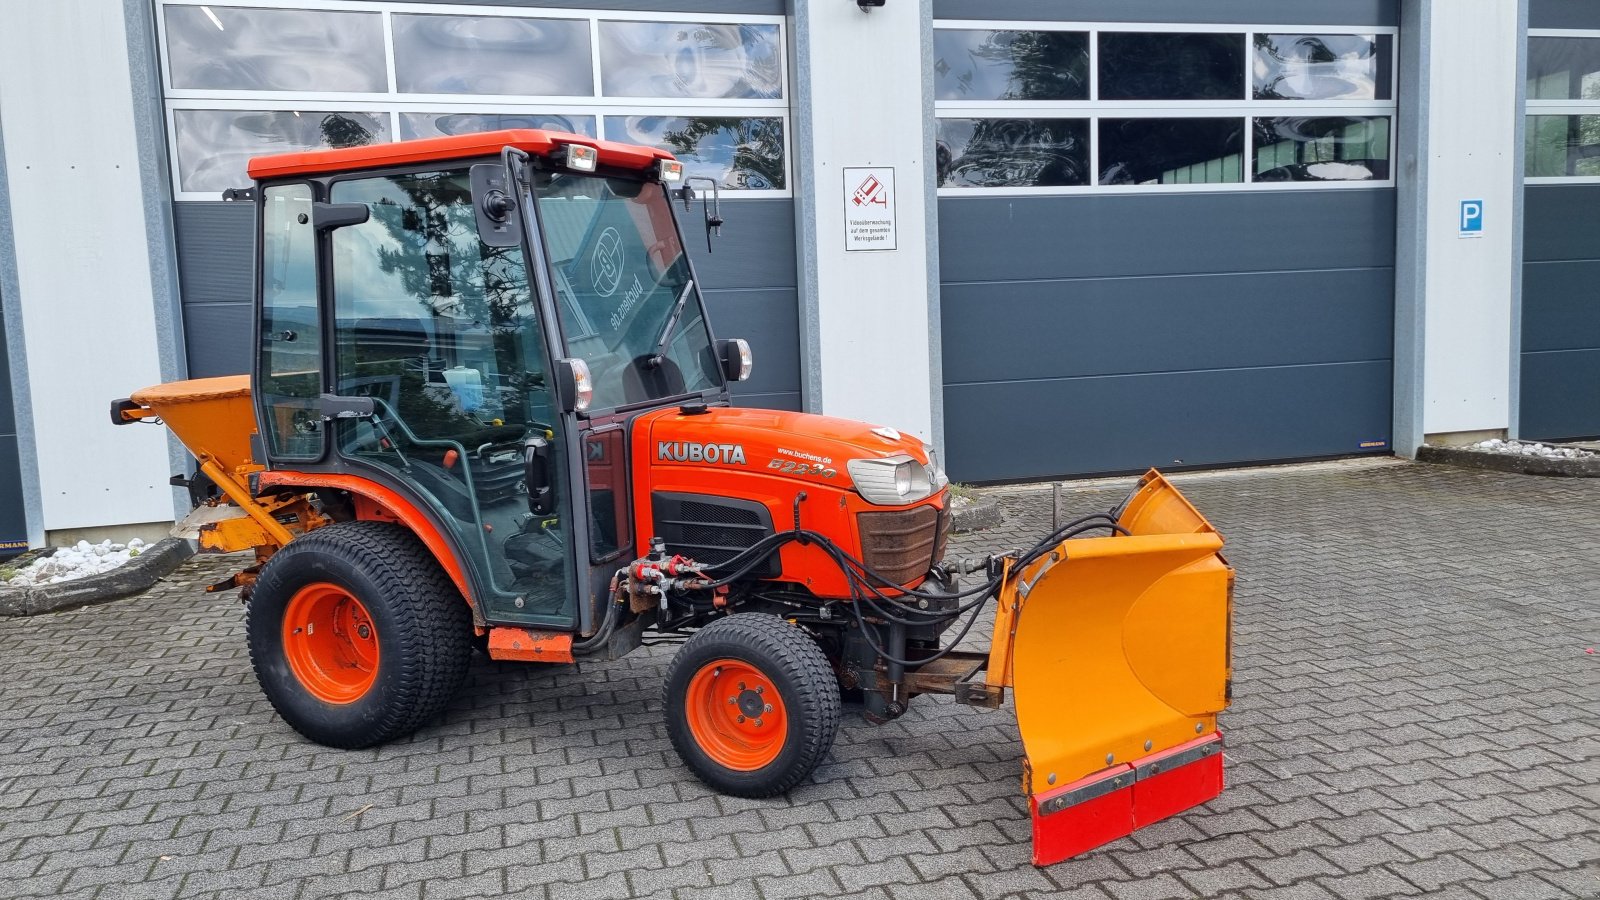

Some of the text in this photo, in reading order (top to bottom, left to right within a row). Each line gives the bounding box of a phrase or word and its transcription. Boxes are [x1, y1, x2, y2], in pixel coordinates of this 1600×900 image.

[1463, 203, 1480, 228] P
[658, 440, 747, 465] KUBOTA
[777, 447, 832, 464] www.buchens.de
